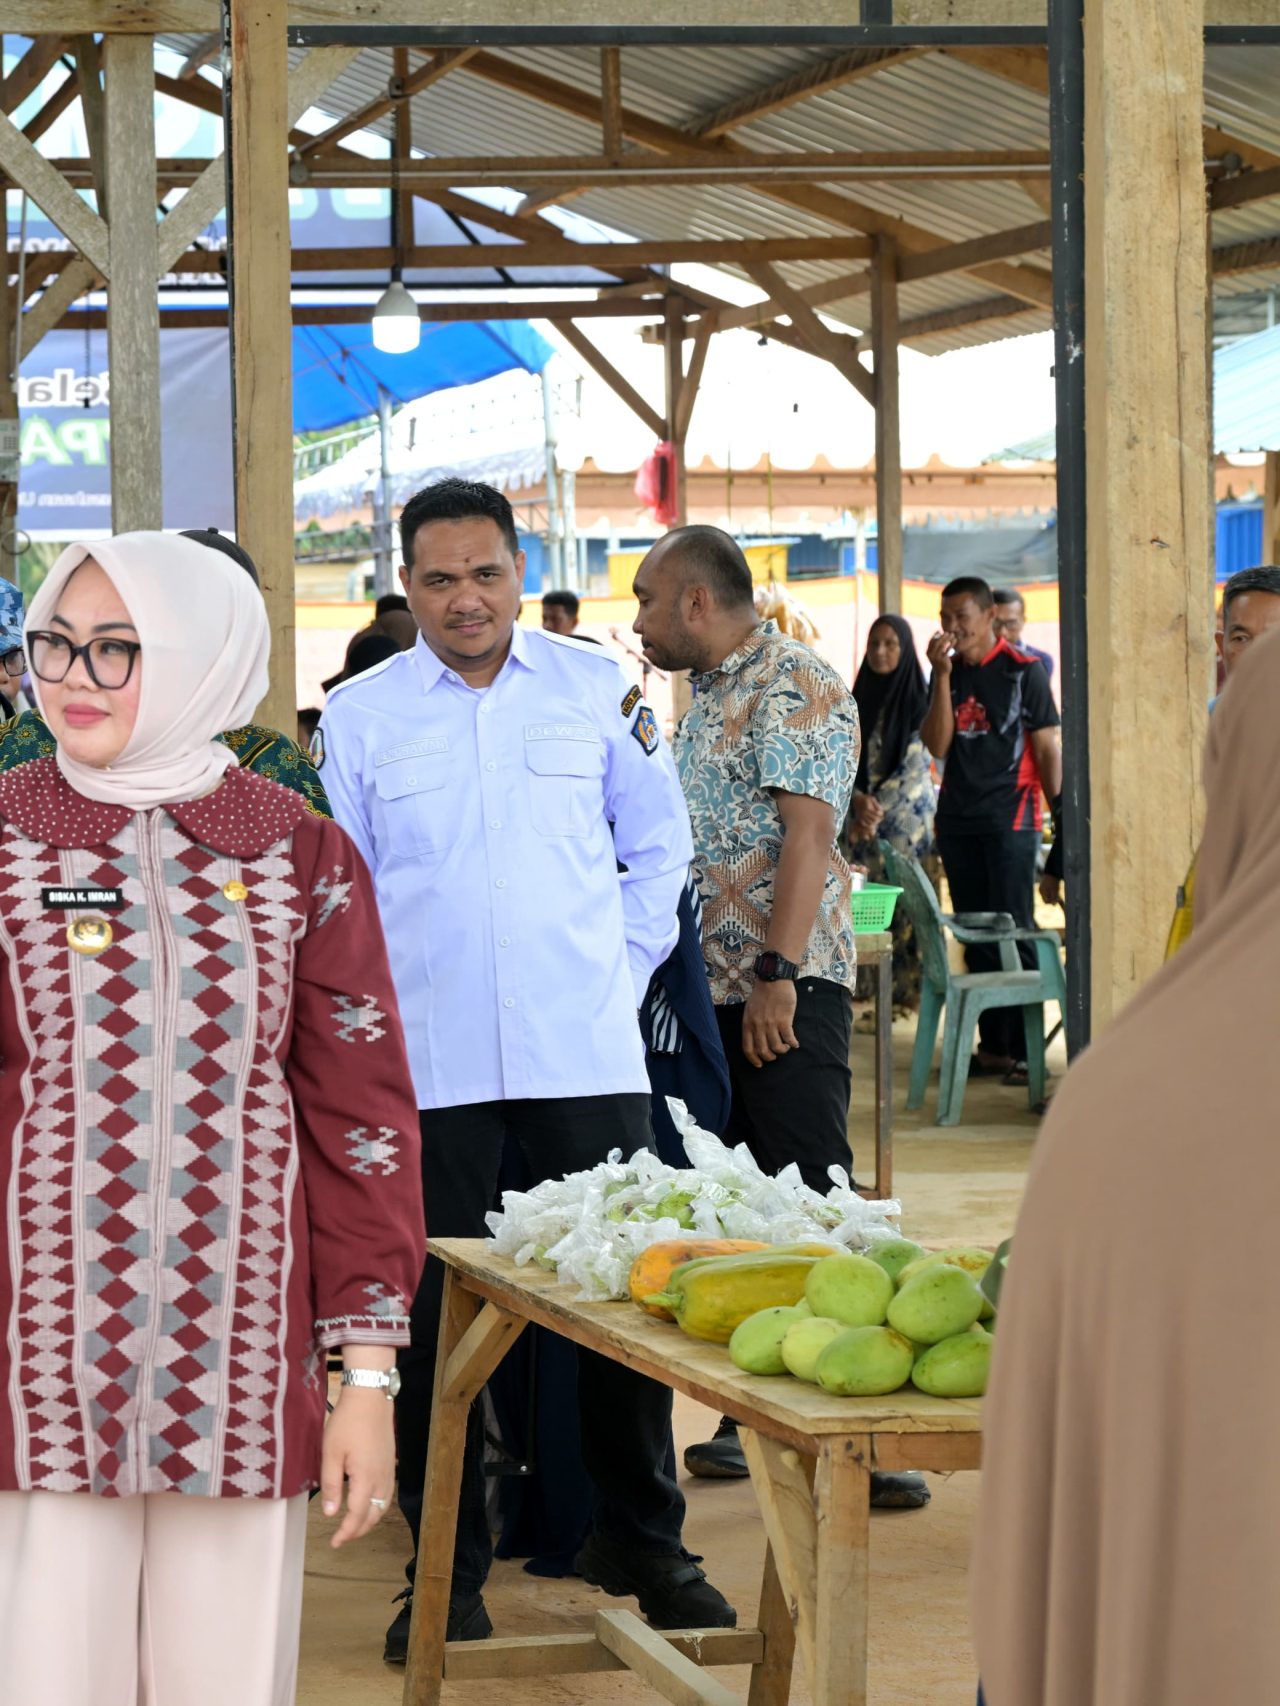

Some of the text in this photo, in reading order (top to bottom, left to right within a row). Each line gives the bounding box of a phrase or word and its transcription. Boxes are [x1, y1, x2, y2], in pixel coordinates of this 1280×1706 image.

[49, 891, 117, 903] SISKA K. IMRAN
